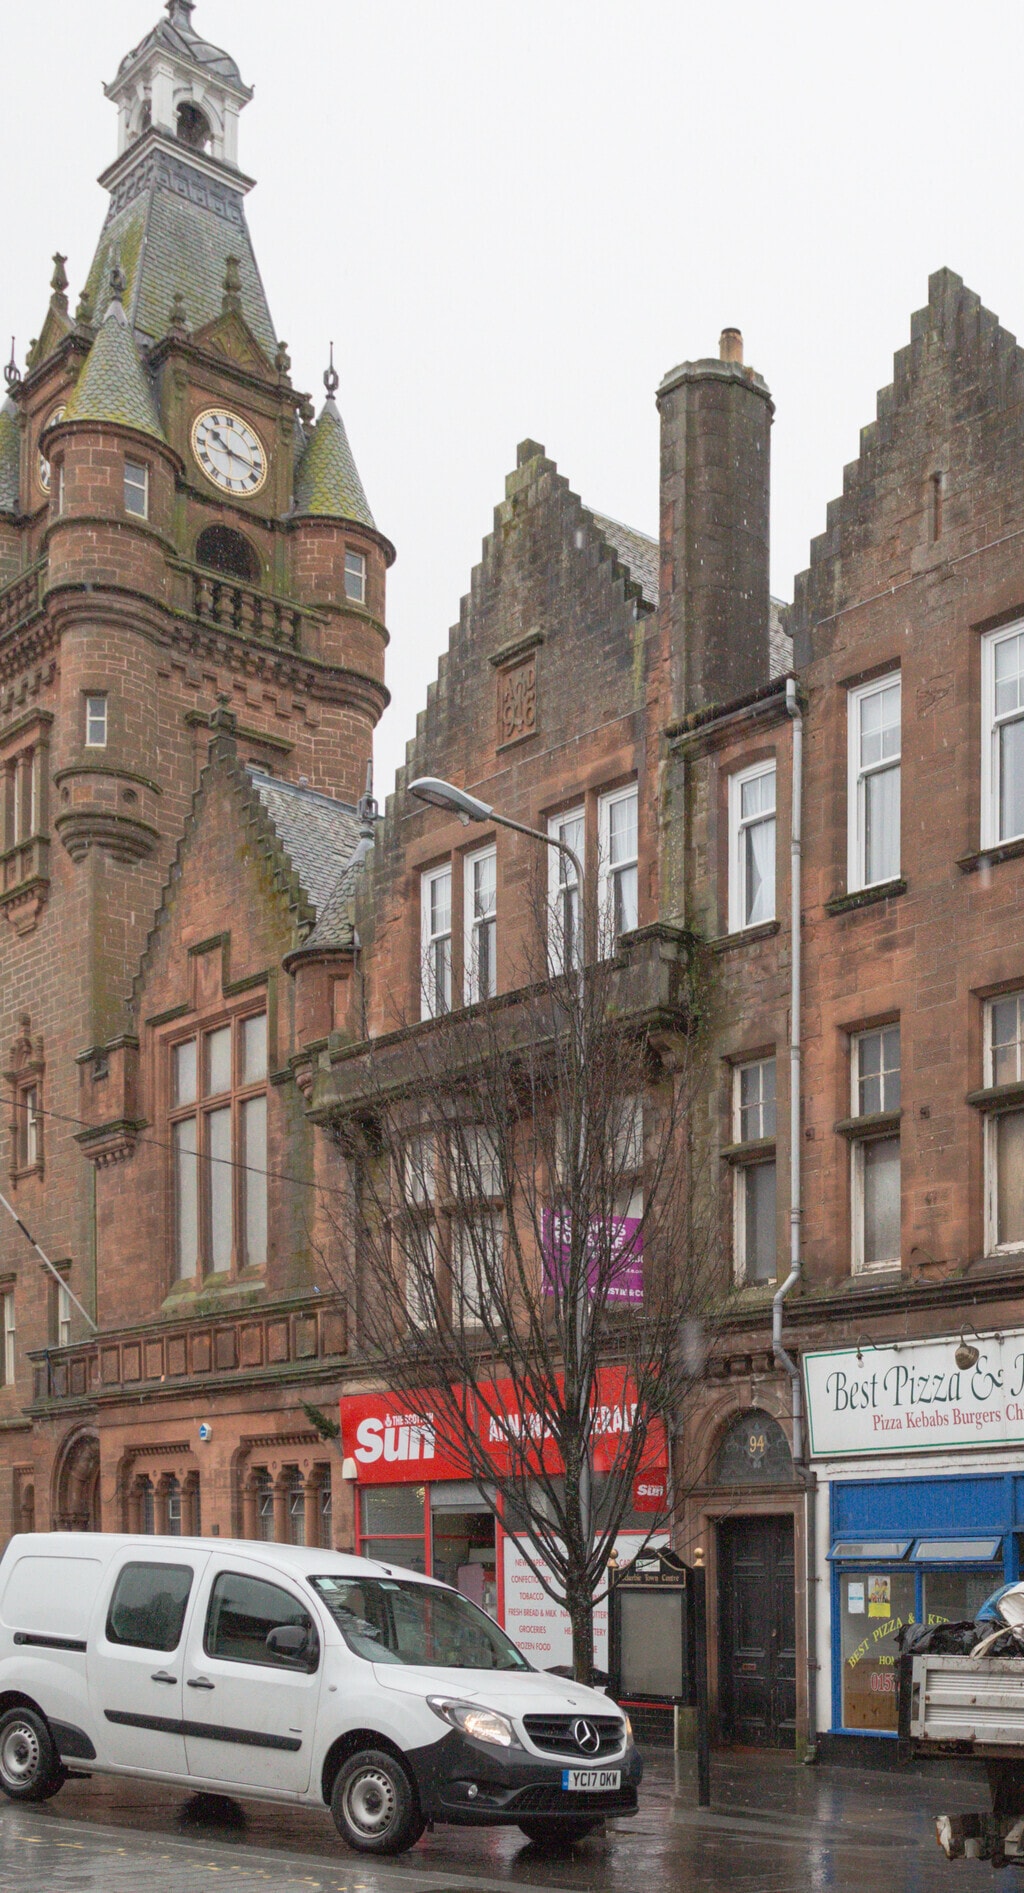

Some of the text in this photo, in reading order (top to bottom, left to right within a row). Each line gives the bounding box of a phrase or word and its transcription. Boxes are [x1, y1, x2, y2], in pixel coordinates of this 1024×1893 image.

[826, 1371, 879, 1411] Best
[882, 1364, 963, 1407] Pizza
[970, 1353, 1004, 1401] &
[872, 1413, 903, 1431] Pizza
[905, 1408, 949, 1428] Kebabs
[952, 1407, 1002, 1431] Burgers
[354, 1417, 435, 1464] Sun
[749, 1434, 765, 1453] 94
[519, 1592, 545, 1601] TOBACCO
[508, 1608, 523, 1616] FRESH
[523, 1608, 540, 1617] BREAD
[545, 1609, 557, 1618] MILK
[518, 1625, 547, 1634] GROCERIES
[535, 1642, 552, 1651] FOOD
[848, 1638, 870, 1668] BEST
[872, 1617, 903, 1643] PIZZA
[907, 1612, 916, 1625] &
[573, 1772, 598, 1787] YC17
